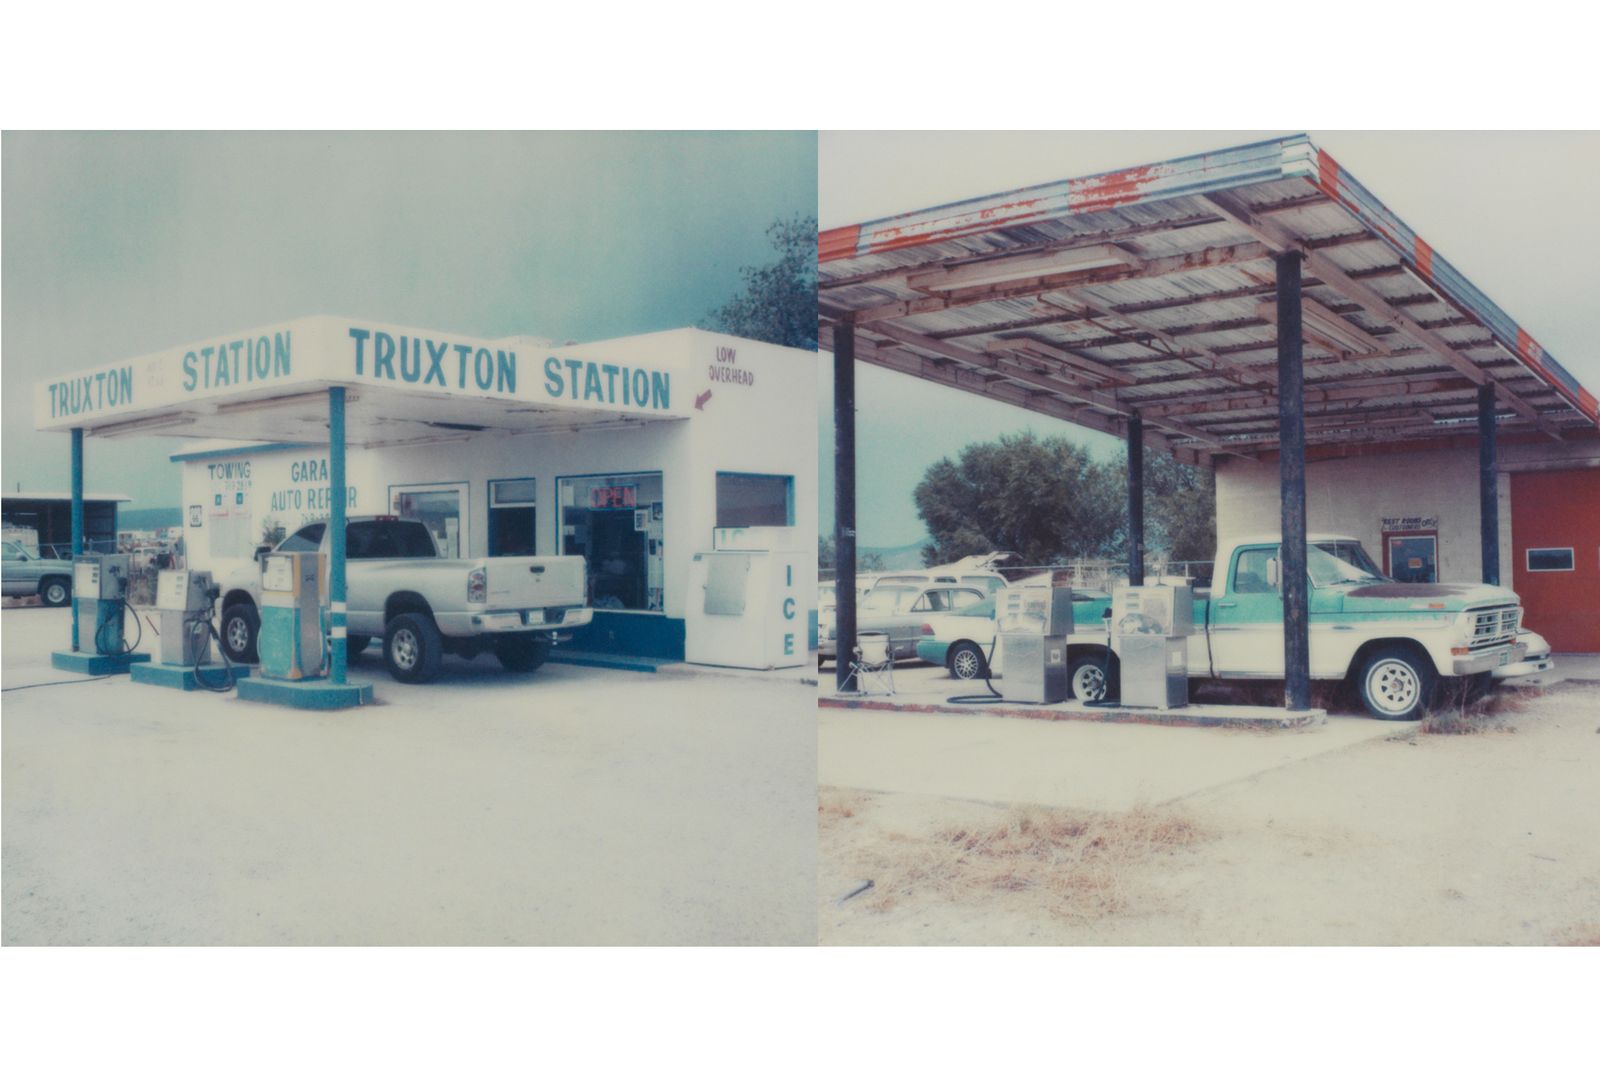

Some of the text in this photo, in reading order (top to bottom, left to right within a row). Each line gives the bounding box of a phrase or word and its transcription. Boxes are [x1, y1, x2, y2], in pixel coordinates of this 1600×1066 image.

[716, 346, 736, 364] LOW
[49, 365, 132, 418] TRUXTON
[182, 330, 291, 392] STATION
[349, 328, 670, 409] TRUXTON STATION
[709, 364, 754, 386] OVERHEAD
[208, 461, 251, 480] TOWING
[291, 459, 328, 482] GARA
[271, 486, 357, 511] AUTO REPR
[591, 487, 635, 508] OPEN
[783, 565, 796, 655] ICE
